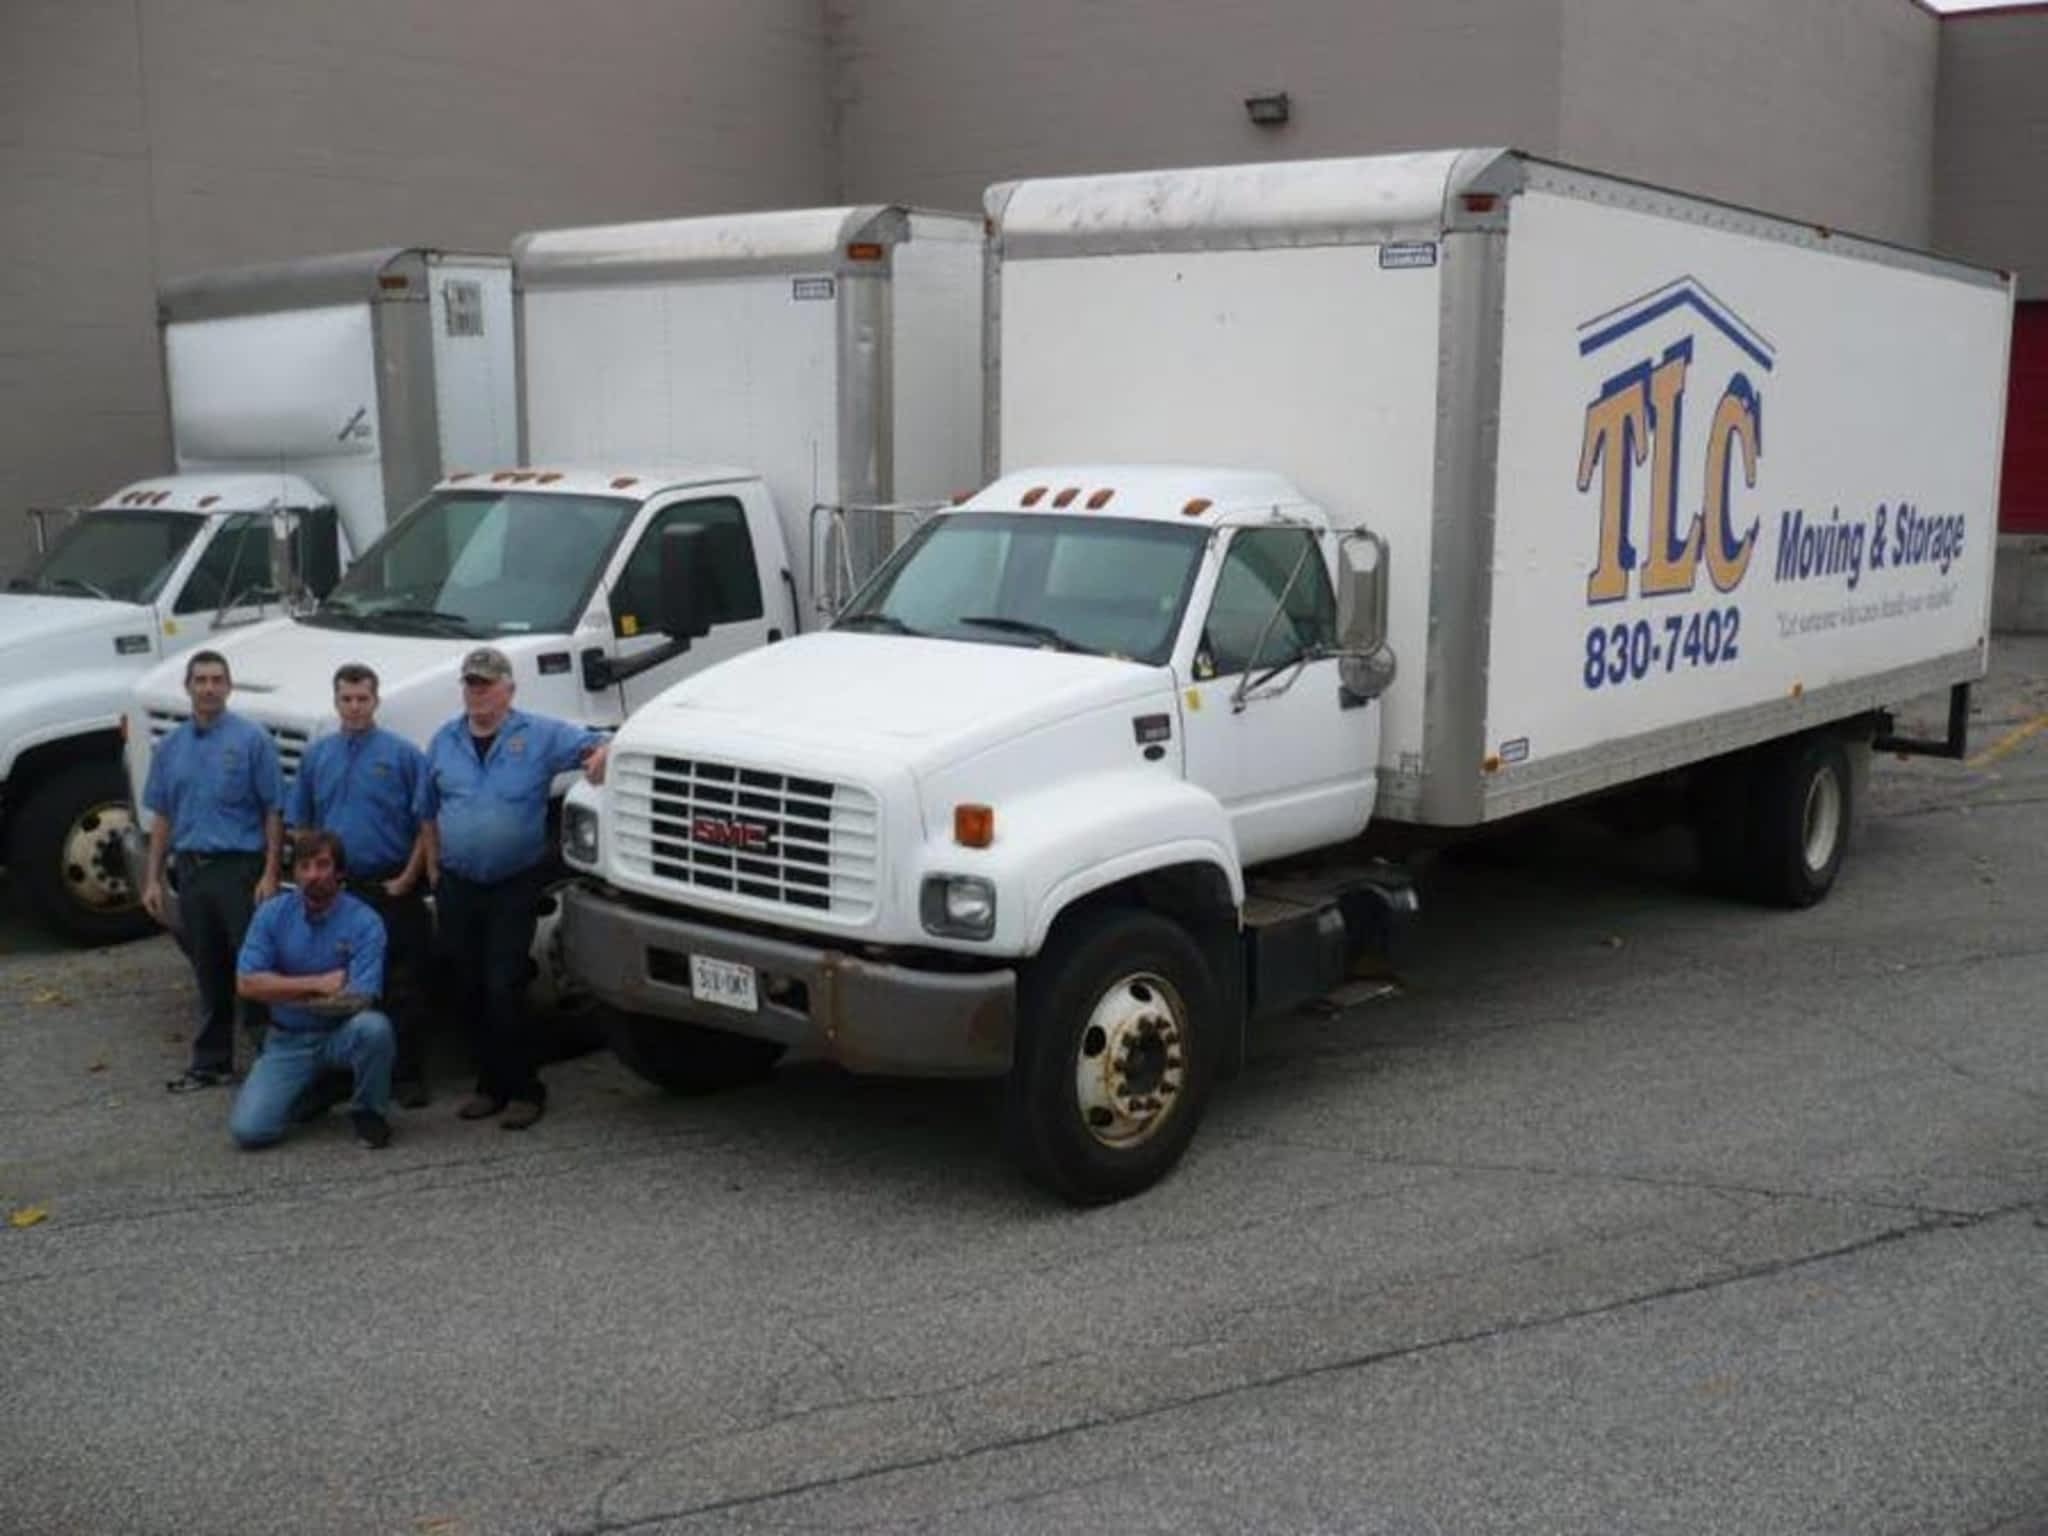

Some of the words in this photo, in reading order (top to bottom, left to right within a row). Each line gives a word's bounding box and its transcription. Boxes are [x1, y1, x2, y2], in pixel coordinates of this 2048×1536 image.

[1577, 334, 1761, 606] TLC
[1775, 506, 1865, 589] Moving
[1870, 503, 1888, 570] &
[1891, 501, 1964, 575] Storage
[1584, 606, 1739, 690] 830-7402
[693, 816, 767, 848] GMC
